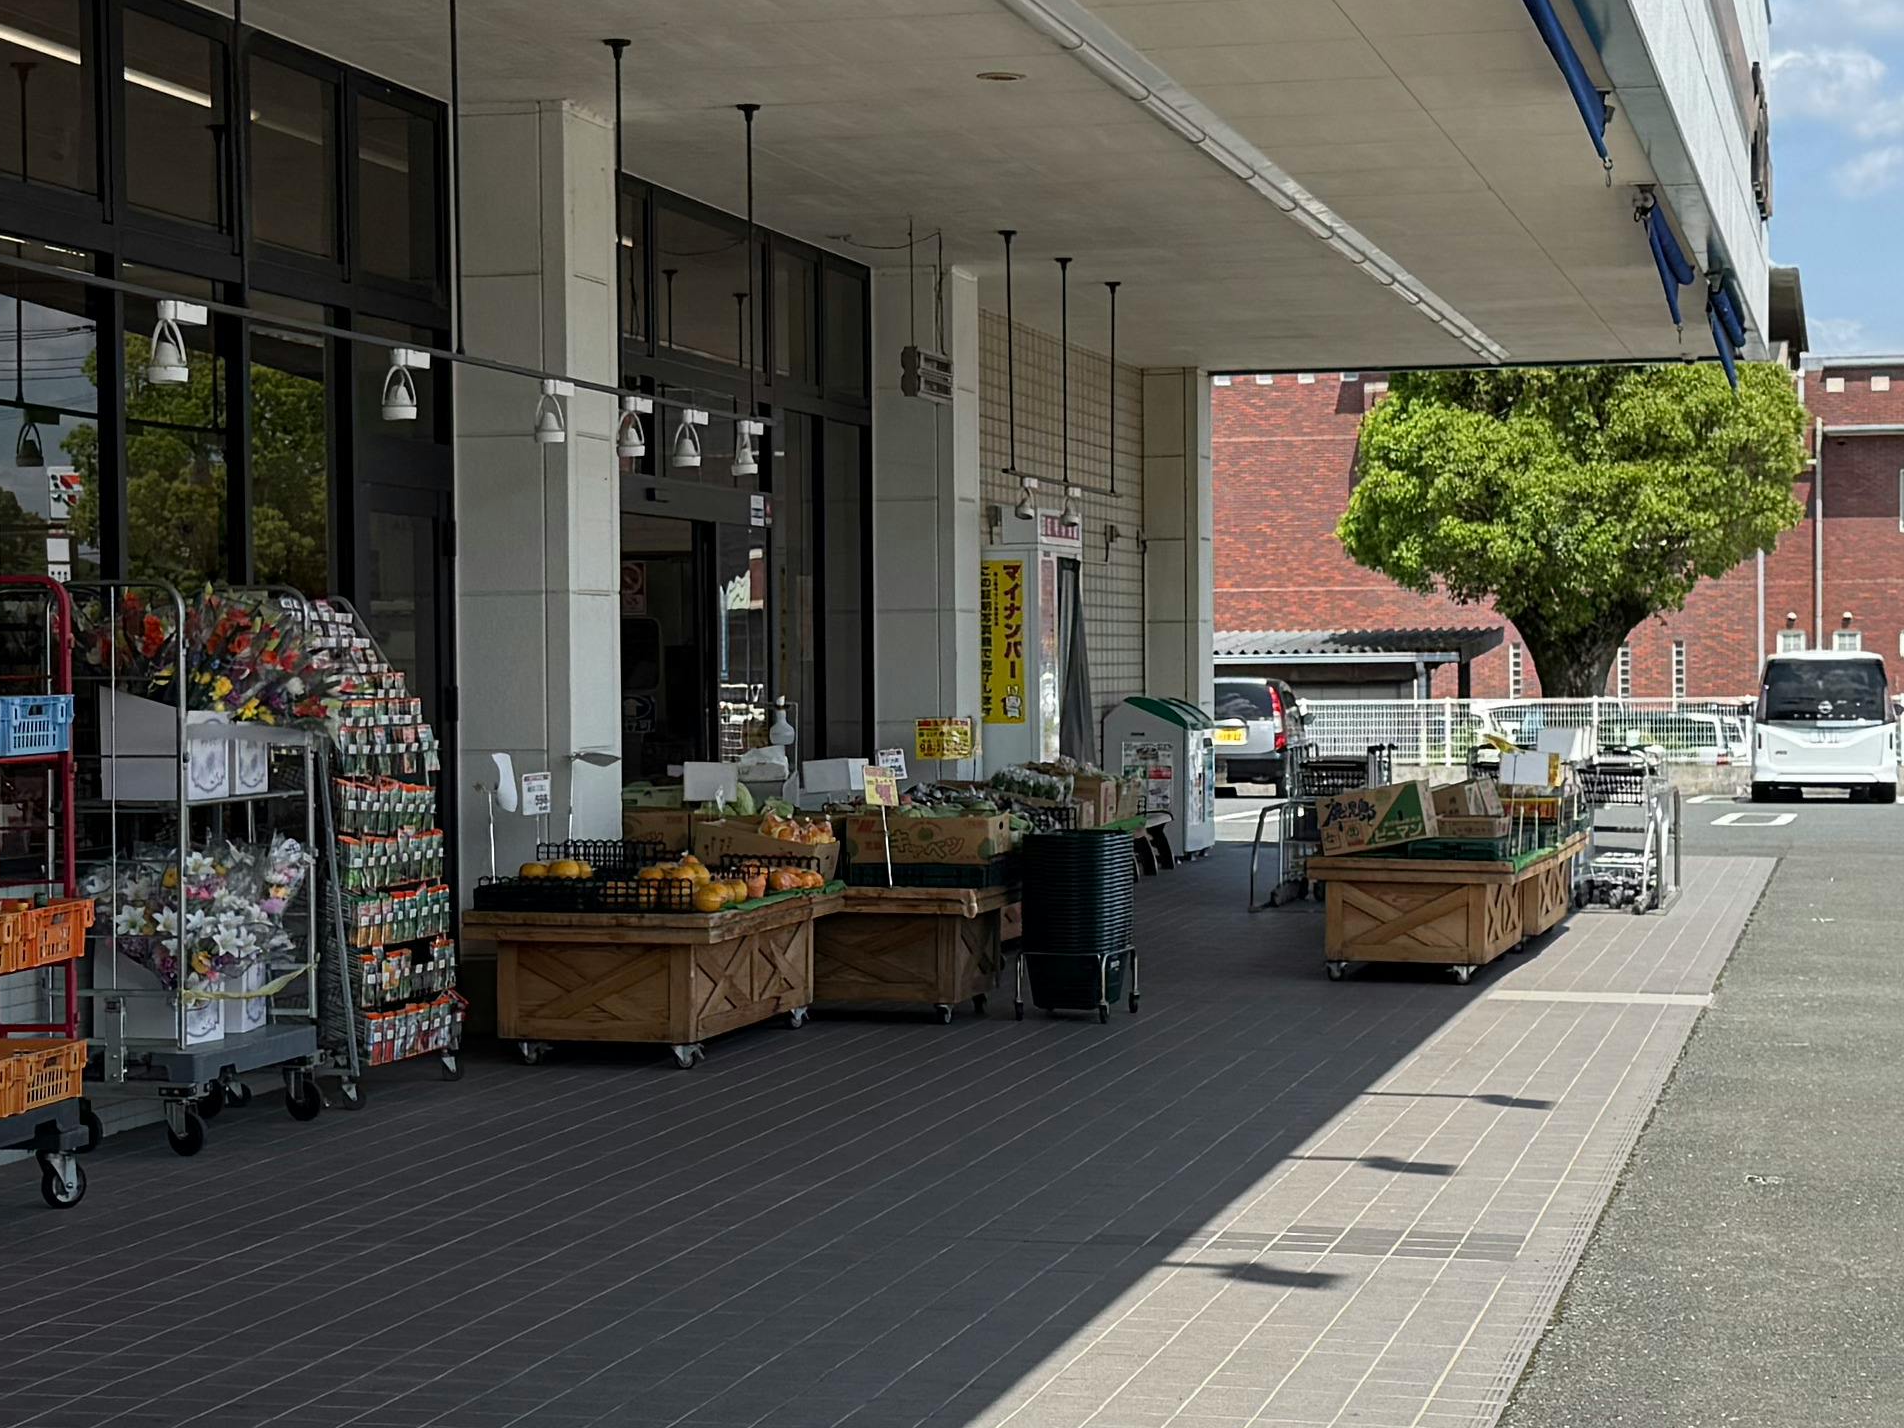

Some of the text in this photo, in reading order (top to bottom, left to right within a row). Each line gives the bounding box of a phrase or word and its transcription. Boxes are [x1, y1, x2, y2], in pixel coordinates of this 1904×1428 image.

[1003, 564, 1023, 679] マイナンバー
